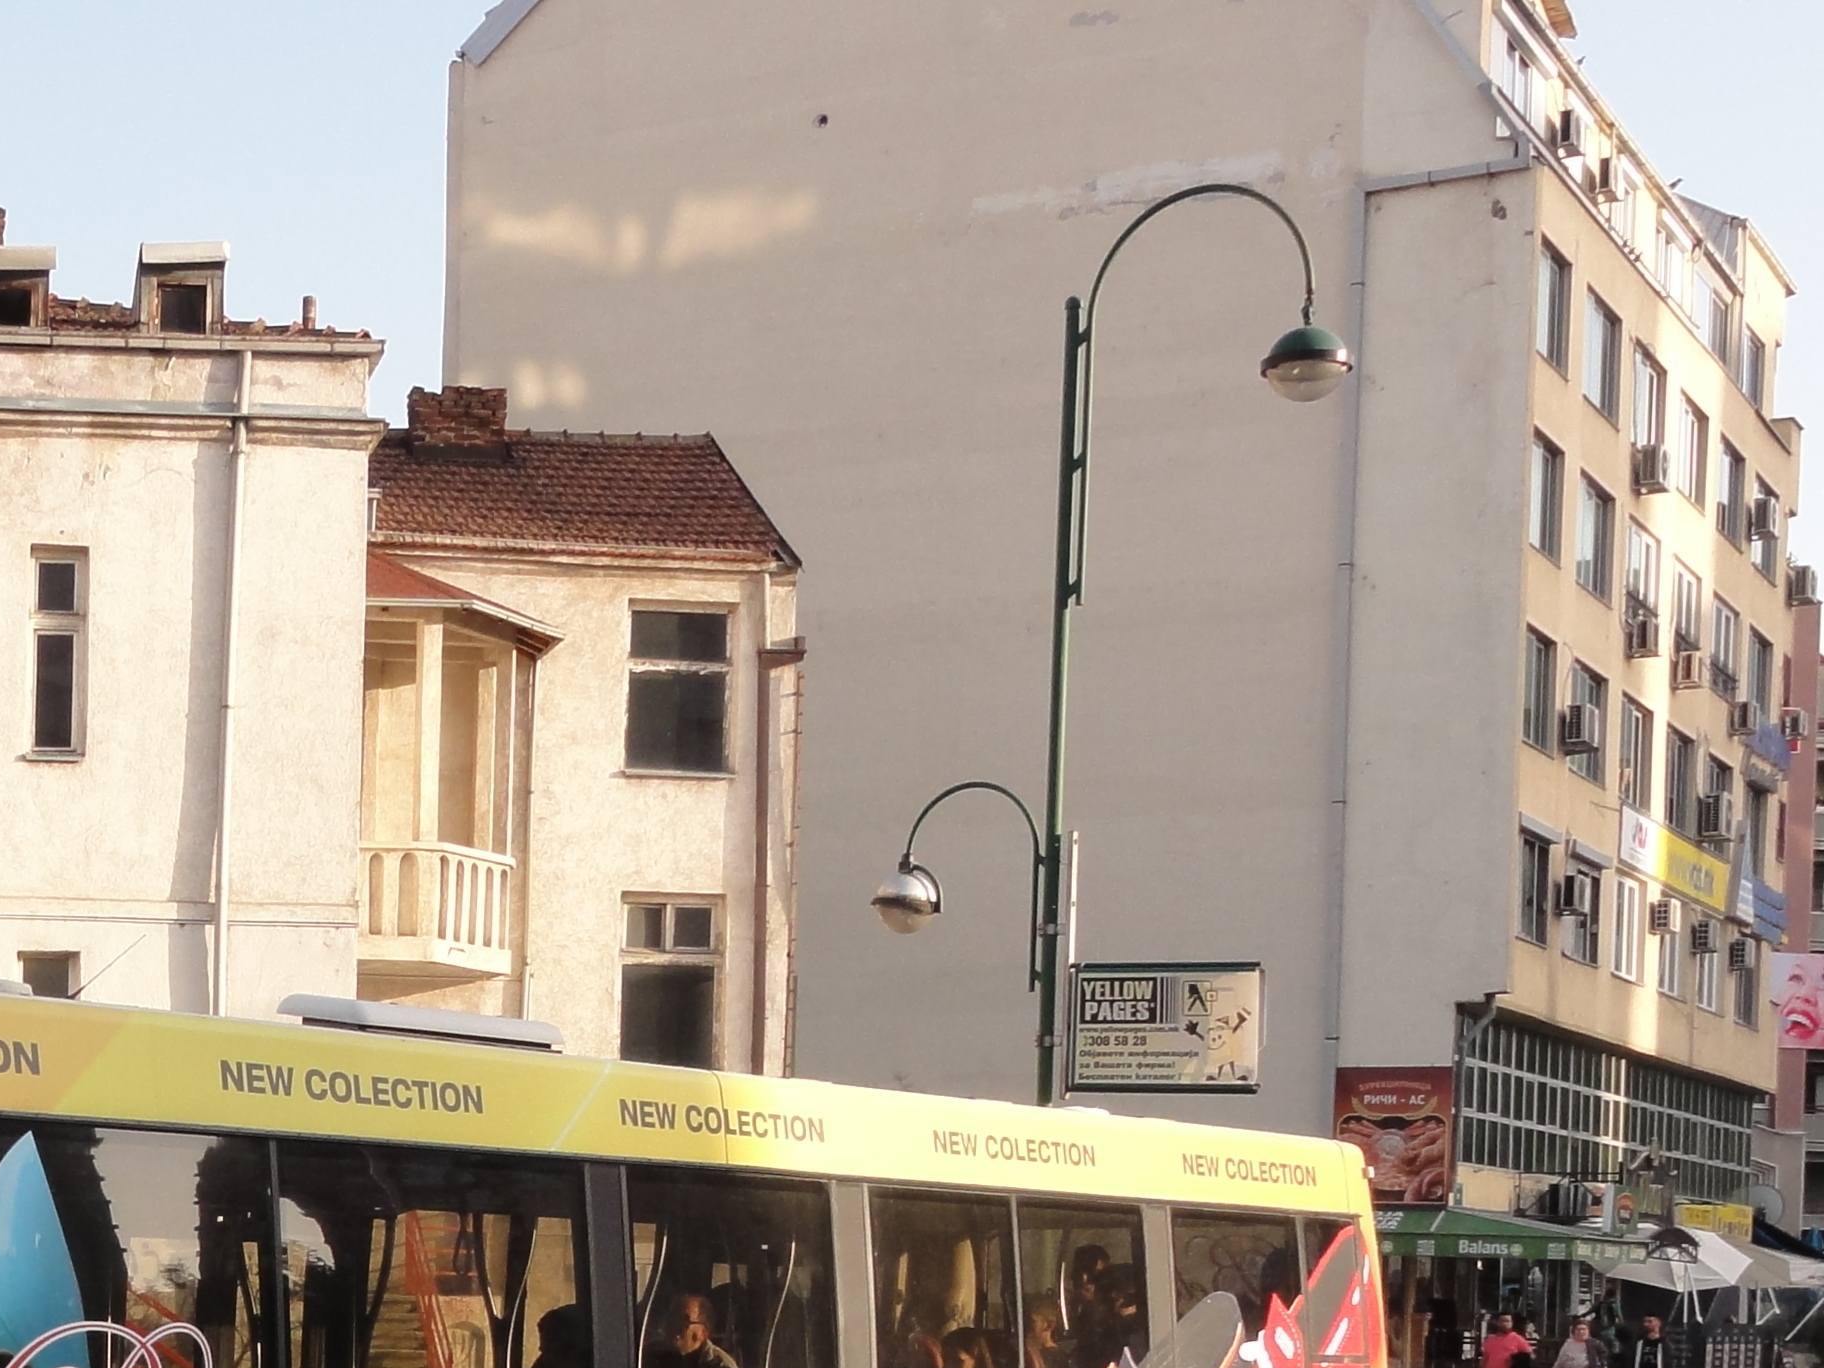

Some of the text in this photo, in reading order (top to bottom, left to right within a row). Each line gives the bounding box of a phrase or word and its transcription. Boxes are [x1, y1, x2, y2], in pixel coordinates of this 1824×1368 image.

[1082, 980, 1153, 1000] YELLOW
[1085, 1002, 1150, 1021] PAGES
[1114, 1035, 1128, 1047] 58
[1132, 1035, 1147, 1047] 28
[221, 1060, 483, 1114] NEW COLECTION
[1363, 1094, 1397, 1105] РИЧИ
[620, 1099, 825, 1143] NEW COLECTION
[933, 1129, 1096, 1167] NEW COLECTION
[1182, 1153, 1317, 1187] NEW COLECTION
[1458, 1239, 1508, 1255] Balans
